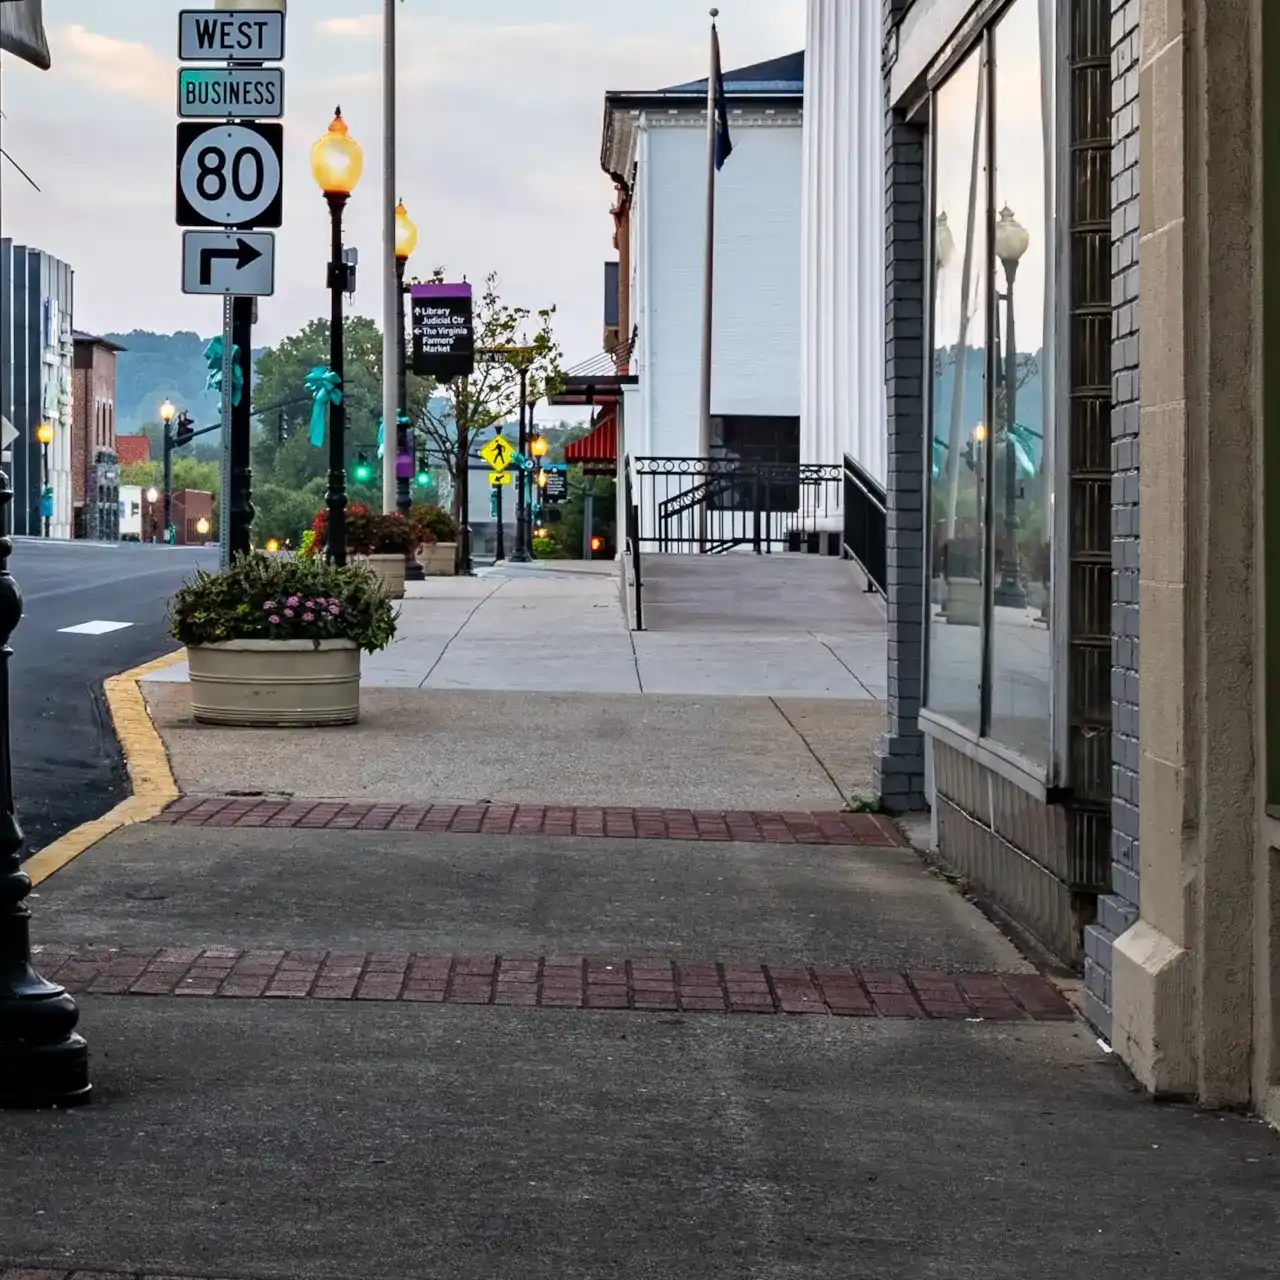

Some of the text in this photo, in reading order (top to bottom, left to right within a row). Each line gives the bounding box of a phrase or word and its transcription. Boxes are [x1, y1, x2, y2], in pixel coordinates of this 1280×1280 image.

[195, 19, 268, 50] WEST
[185, 81, 276, 105] BUSINESS
[196, 146, 264, 202] 80
[422, 308, 450, 316] Library
[421, 316, 465, 325] Judicial Ctr
[422, 327, 468, 336] The Virginia
[422, 344, 451, 353] Market
